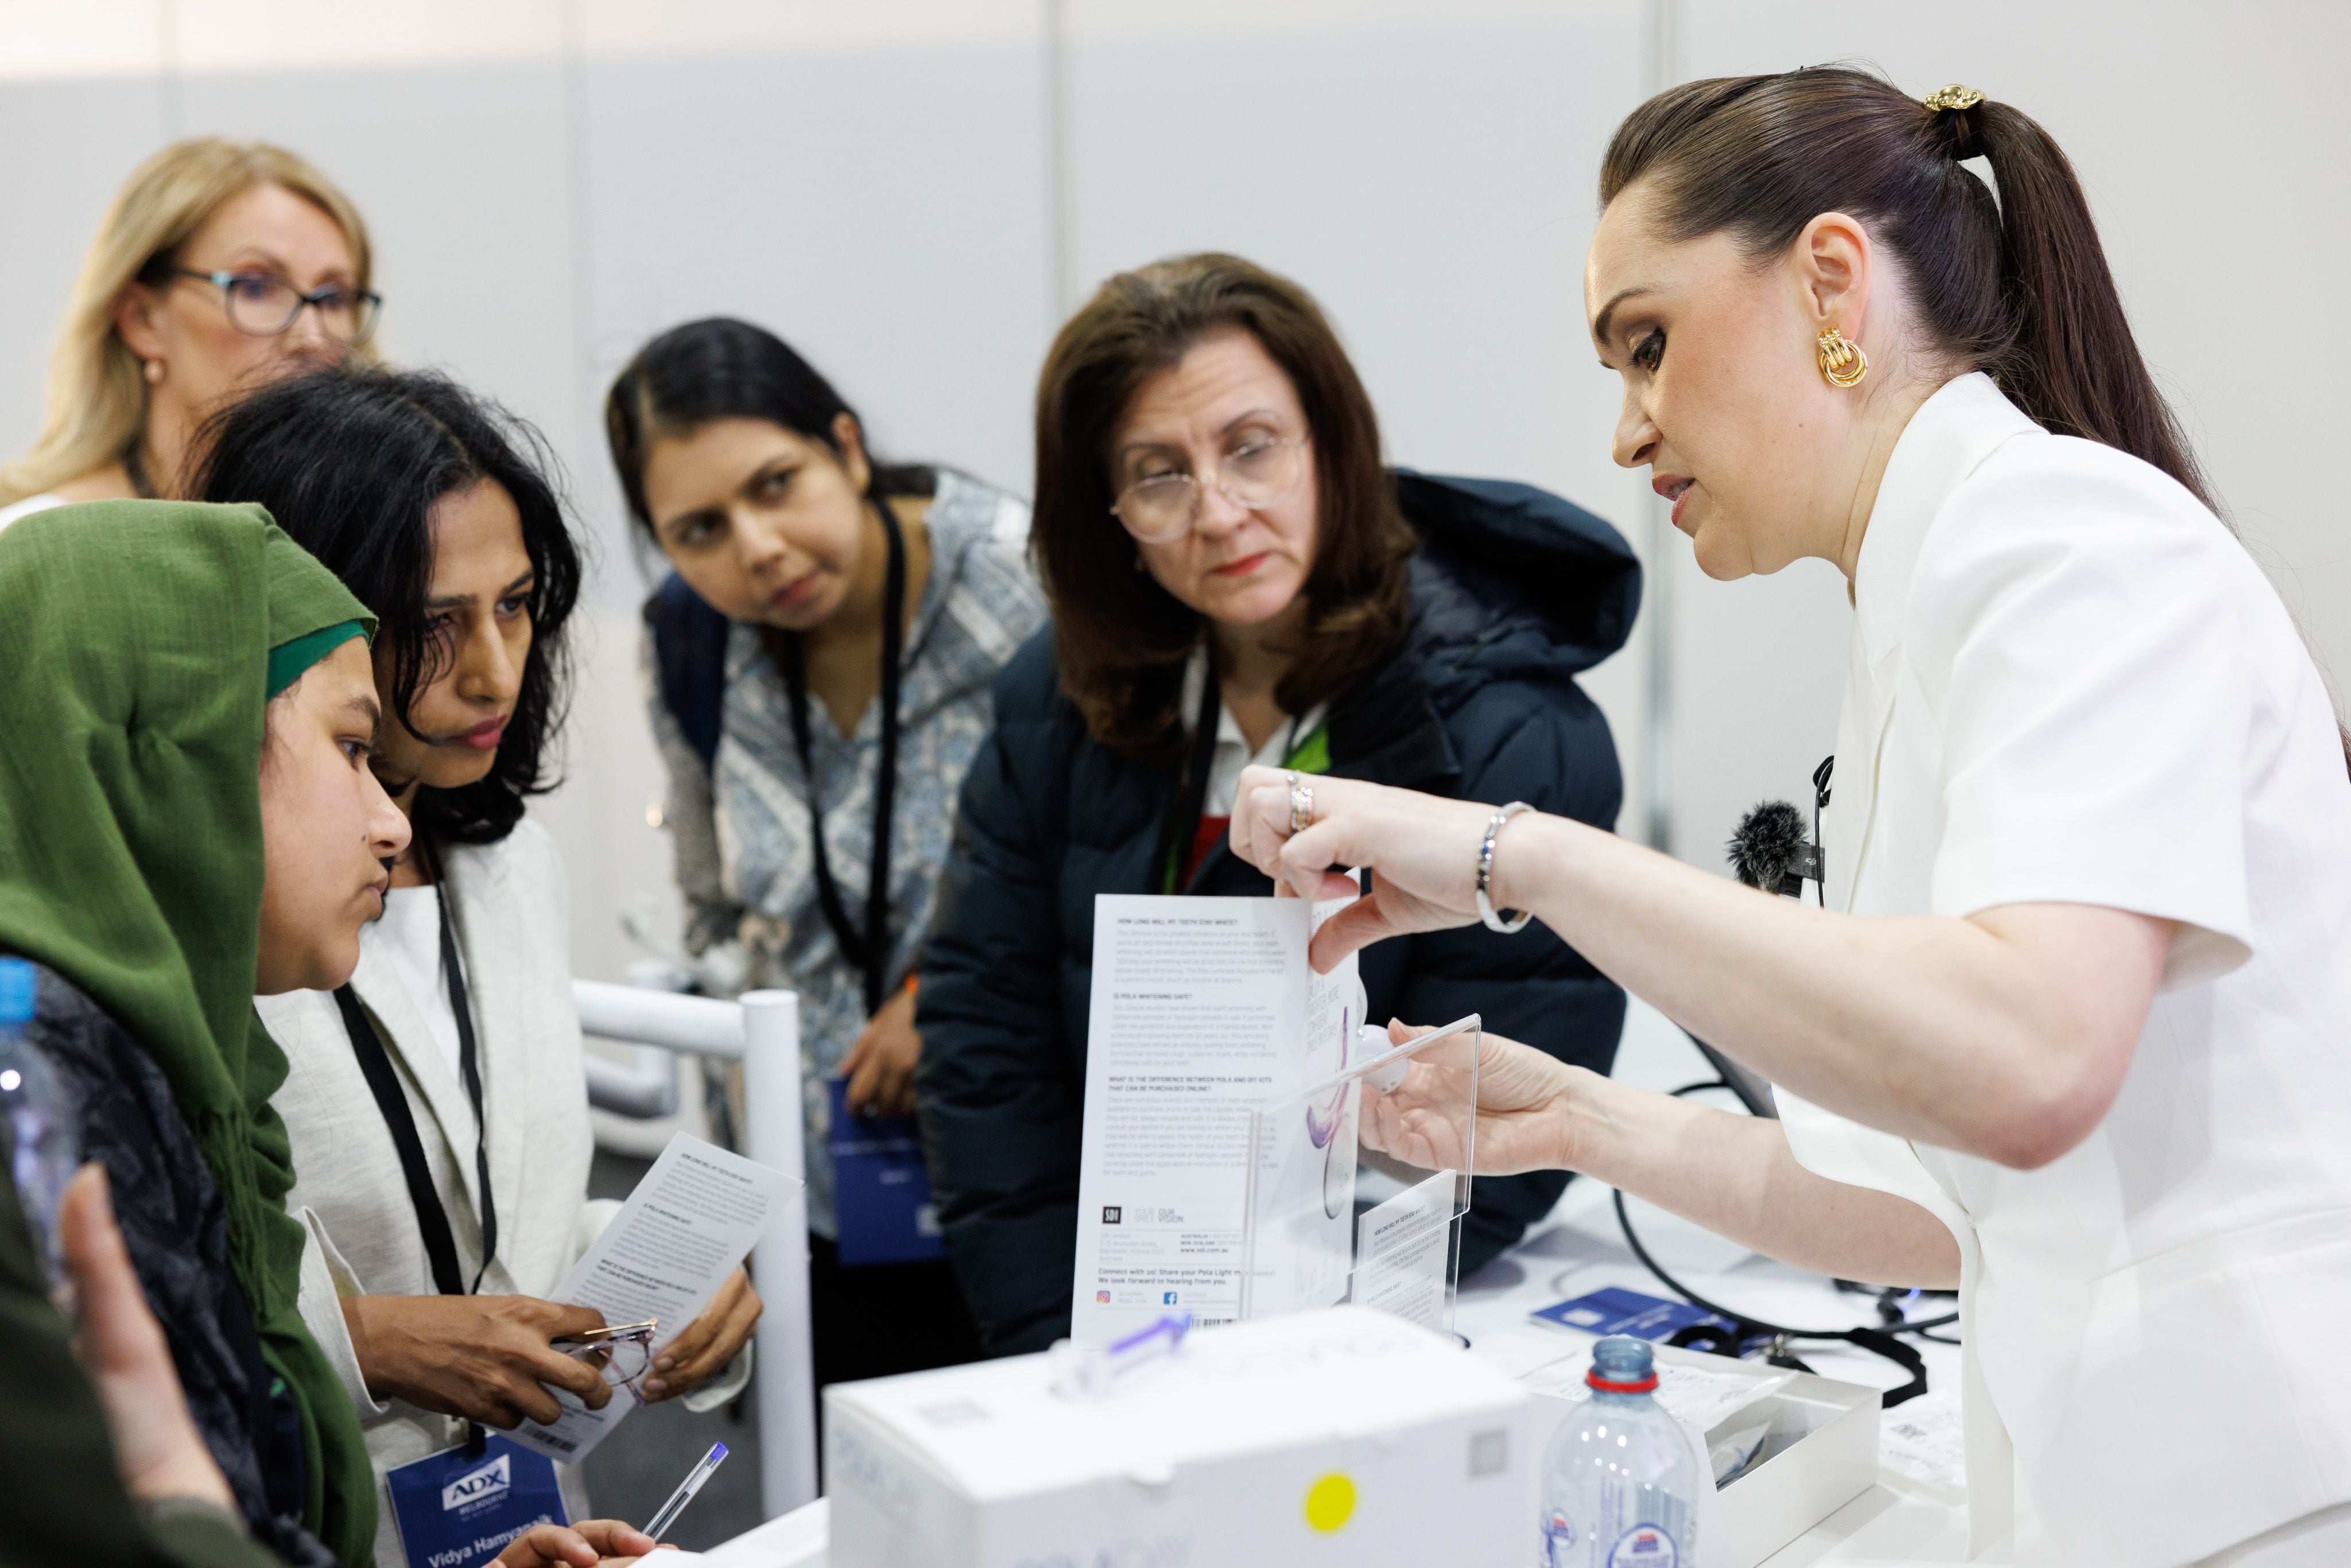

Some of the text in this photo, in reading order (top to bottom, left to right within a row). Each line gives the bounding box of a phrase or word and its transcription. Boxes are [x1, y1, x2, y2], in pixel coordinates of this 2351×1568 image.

[1104, 1208, 1119, 1221] SDI
[452, 1469, 506, 1500] ADX
[428, 1546, 472, 1568] Vidya
